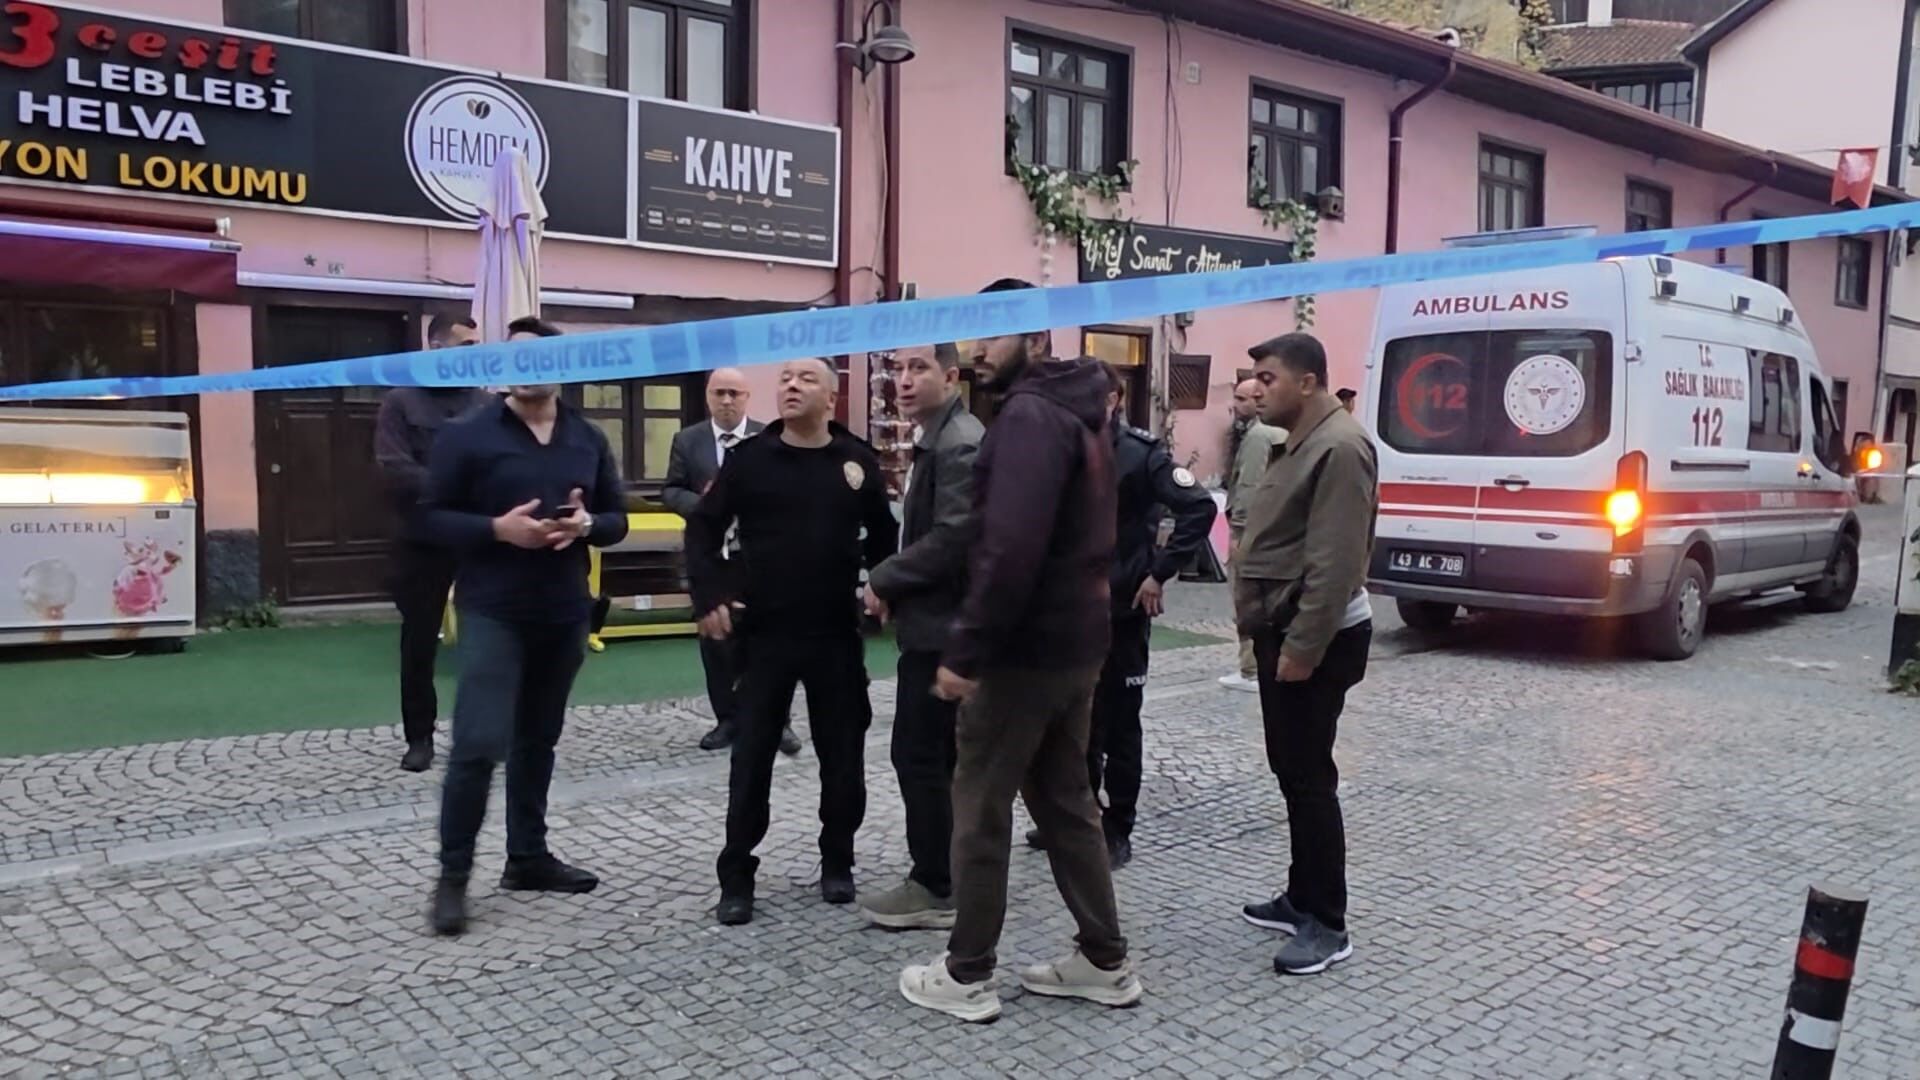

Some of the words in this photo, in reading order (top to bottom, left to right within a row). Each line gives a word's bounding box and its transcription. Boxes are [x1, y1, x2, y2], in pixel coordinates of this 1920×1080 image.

[0, 2, 59, 68] 3
[66, 57, 292, 115] LEBLEBİ
[17, 90, 206, 146] HELVA
[119, 152, 307, 203] LOKUMU
[684, 136, 794, 198] KAHVE
[1129, 235, 1182, 272] Sanat
[1413, 291, 1569, 317] AMBULANS
[1414, 383, 1467, 409] 112
[1665, 367, 1698, 397] SAĞLIK
[1692, 406, 1723, 447] 112
[10, 521, 116, 534] GELATERIA
[1397, 552, 1412, 566] 43
[1418, 555, 1432, 569] AC
[1440, 557, 1461, 571] 708
